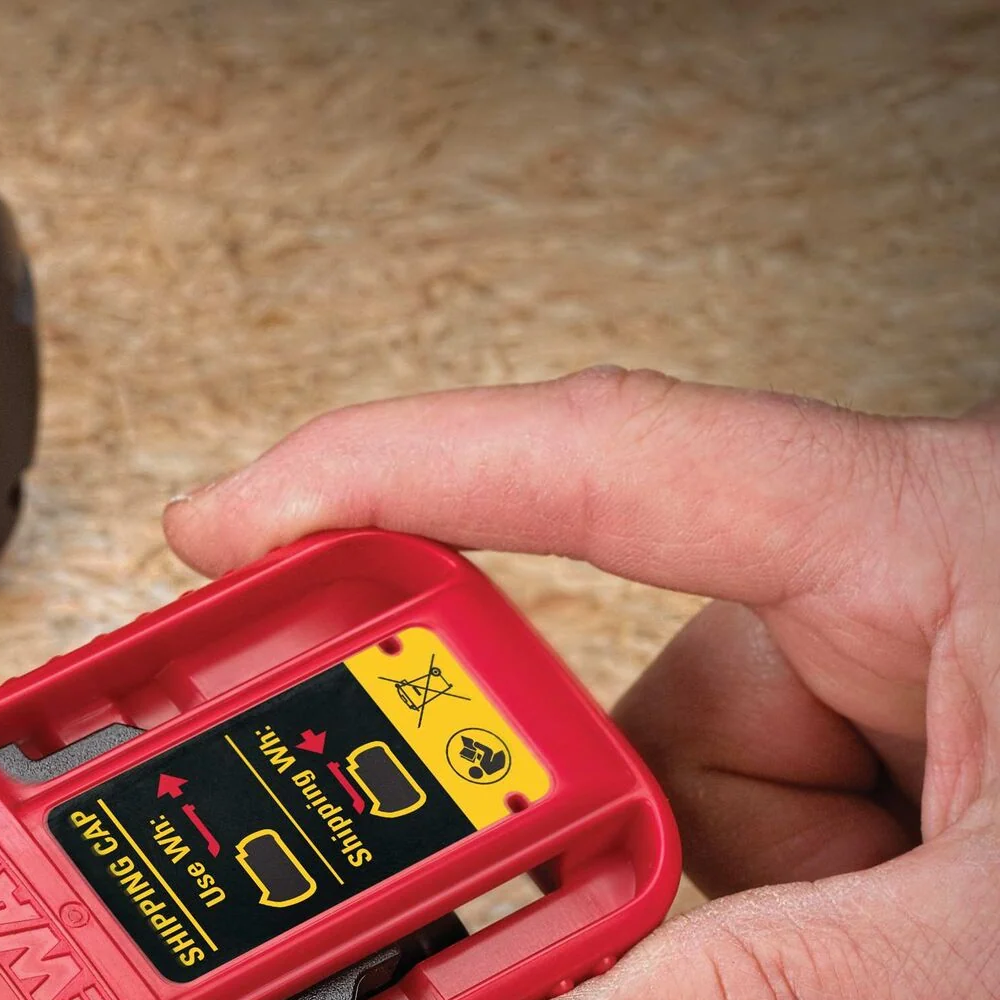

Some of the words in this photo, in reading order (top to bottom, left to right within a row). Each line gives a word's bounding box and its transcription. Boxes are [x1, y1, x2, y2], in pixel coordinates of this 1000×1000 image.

[254, 724, 298, 775] Wh:
[69, 810, 119, 857] CAP
[150, 815, 189, 863] Wh:
[292, 769, 373, 868] Shipping
[187, 861, 226, 909] Use
[108, 858, 205, 968] SHIPPING
